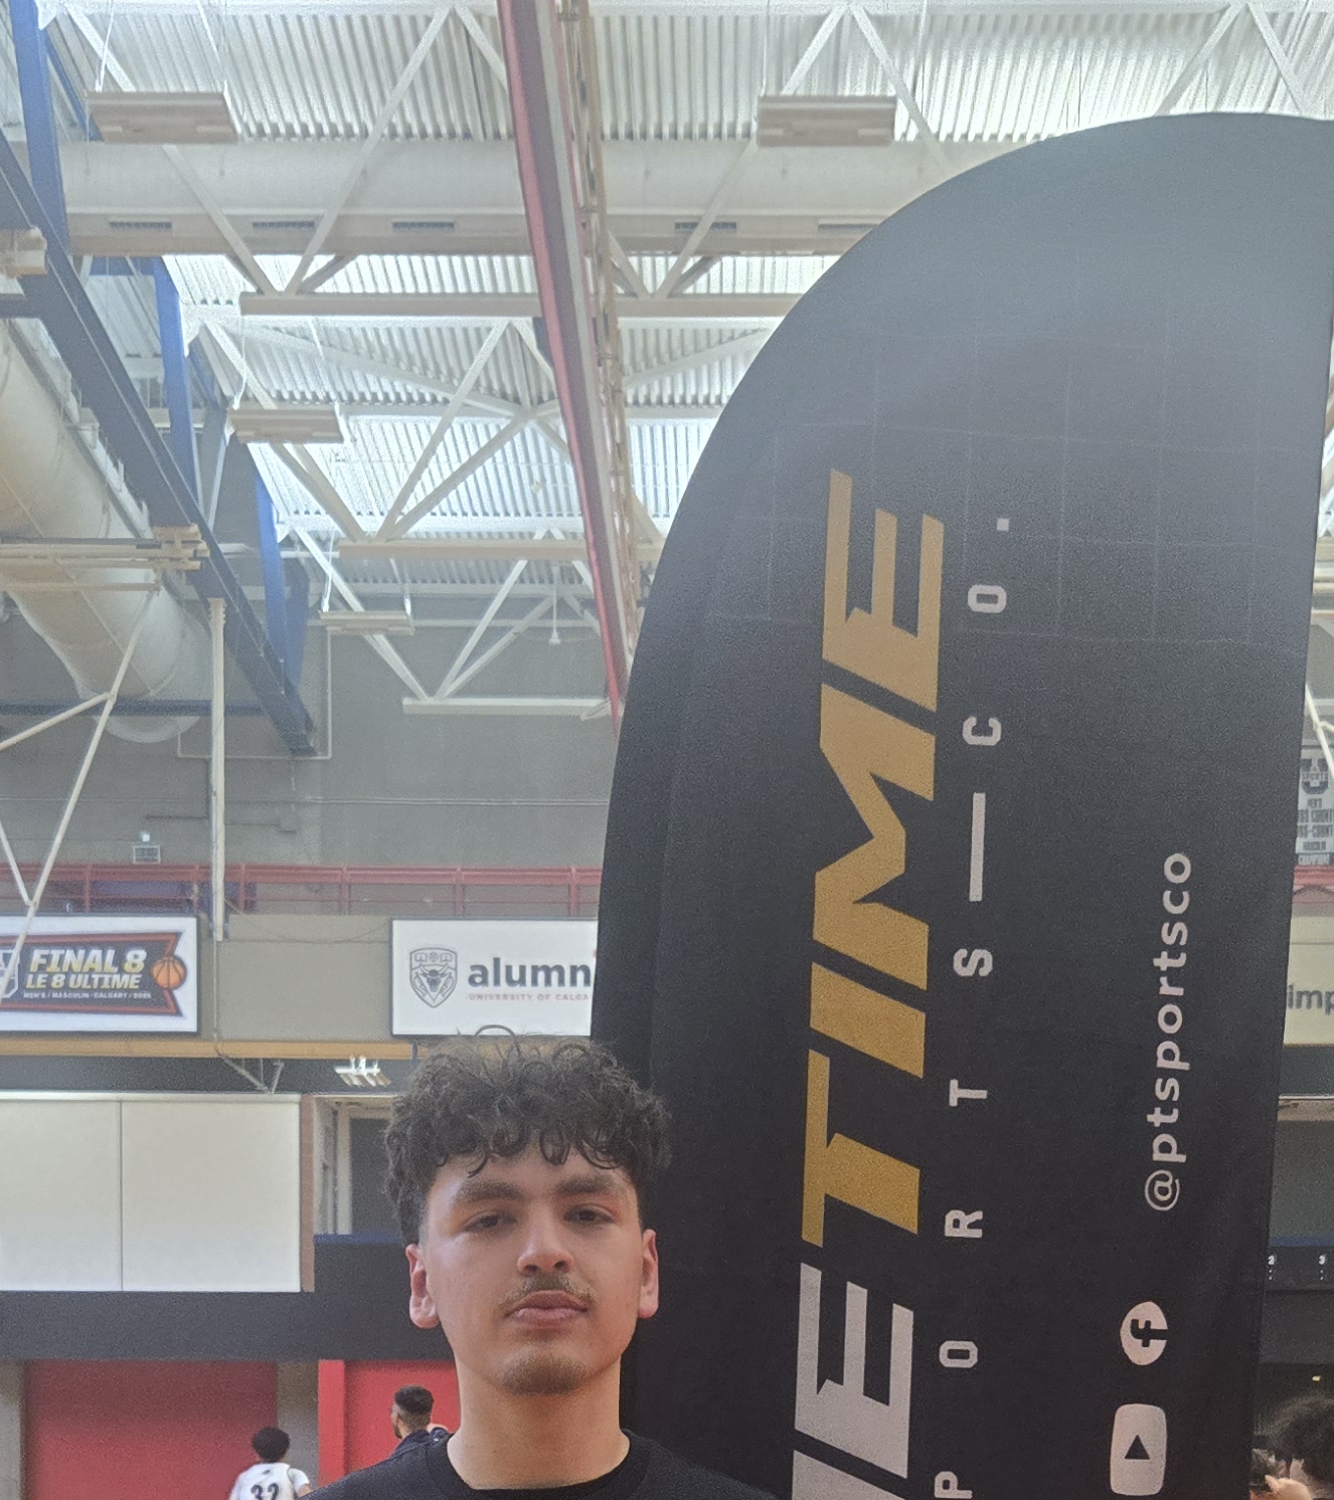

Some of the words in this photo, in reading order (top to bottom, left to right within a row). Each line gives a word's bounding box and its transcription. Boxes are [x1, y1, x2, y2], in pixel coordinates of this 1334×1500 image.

[28, 948, 121, 972] FINAL
[123, 947, 148, 972] 8
[468, 950, 596, 987] alumn
[25, 974, 48, 989] LE
[51, 974, 65, 989] 8
[69, 974, 142, 989] ULTIME
[1144, 853, 1191, 1212] @ptsportsco
